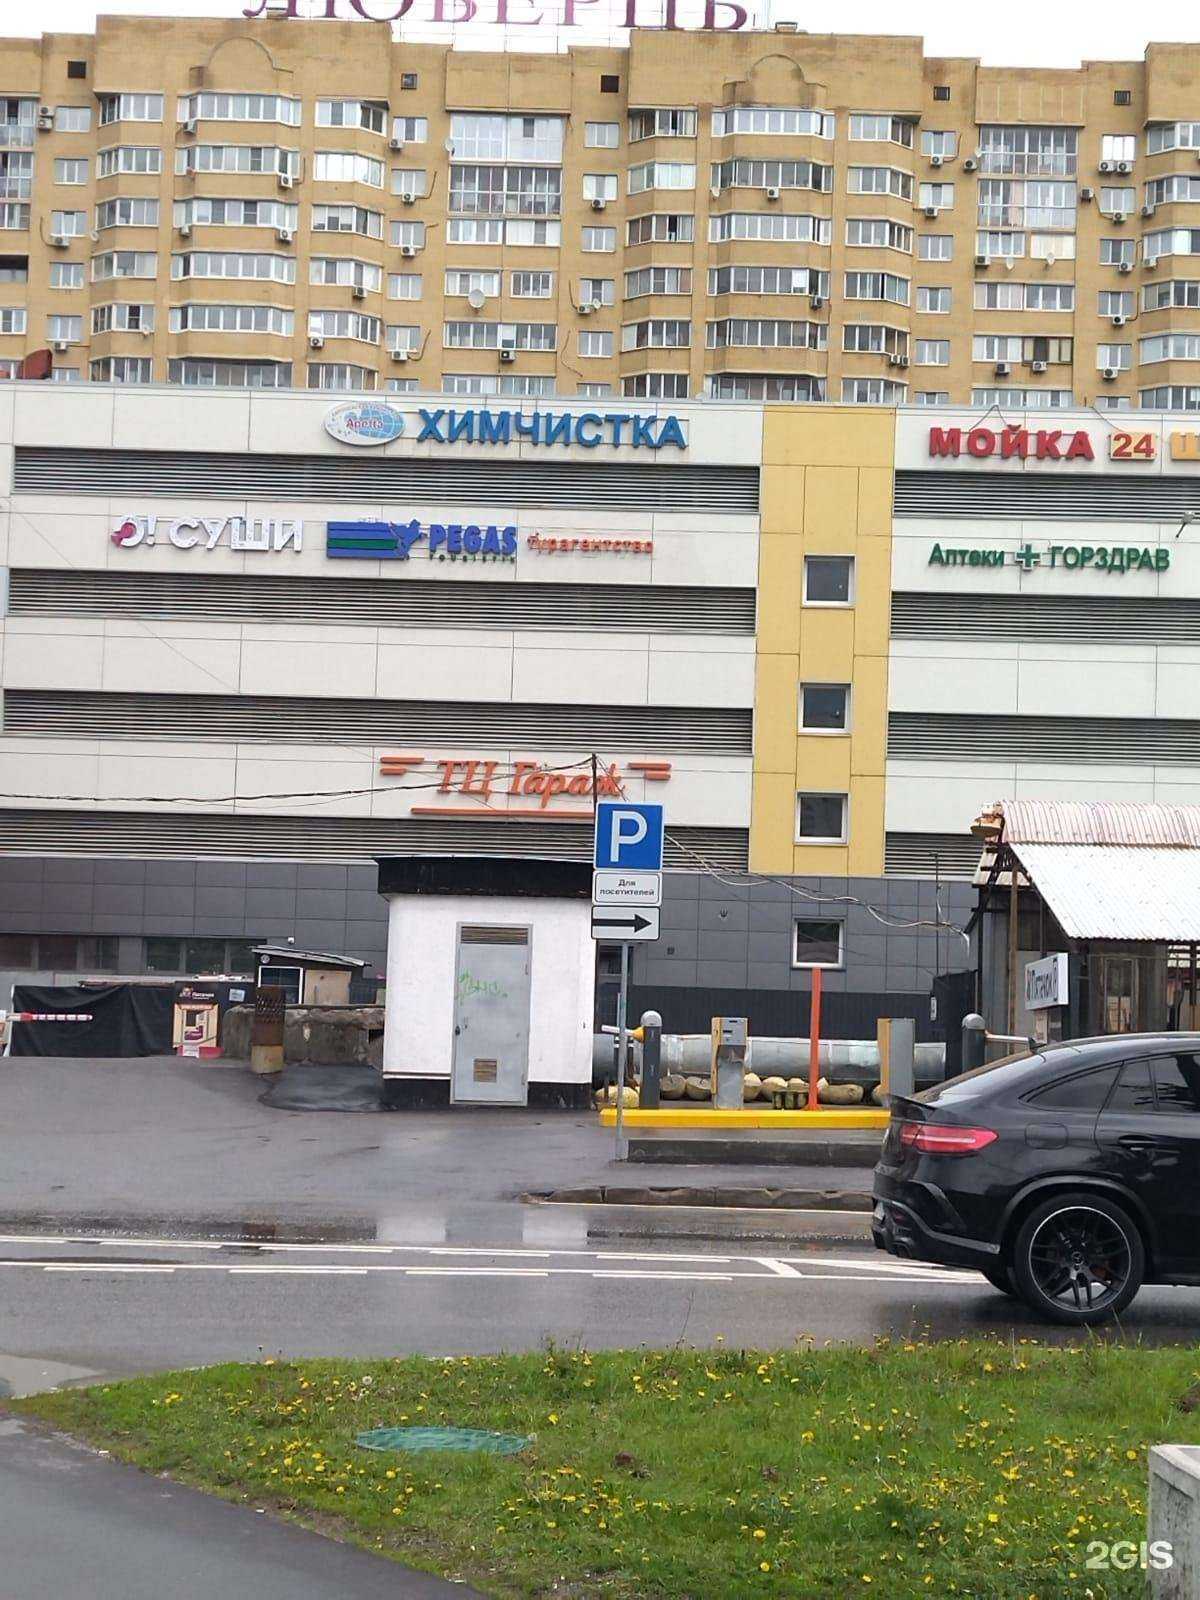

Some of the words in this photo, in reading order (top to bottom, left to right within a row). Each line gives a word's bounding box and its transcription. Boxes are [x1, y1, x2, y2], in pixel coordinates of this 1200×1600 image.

[417, 408, 687, 450] ХИМЧИСТКА
[929, 424, 1095, 460] МОЙКА
[1112, 433, 1154, 458] 24
[169, 516, 303, 552] СУШИ
[429, 524, 517, 554] PEGAS
[928, 543, 1005, 568] Аптеки
[1048, 546, 1170, 574] ГОРЗДРАВ
[437, 760, 498, 802] ТЦ
[507, 762, 626, 808] Гараж
[610, 810, 648, 863] P
[600, 888, 655, 896] посетителей
[618, 879, 636, 887] Для
